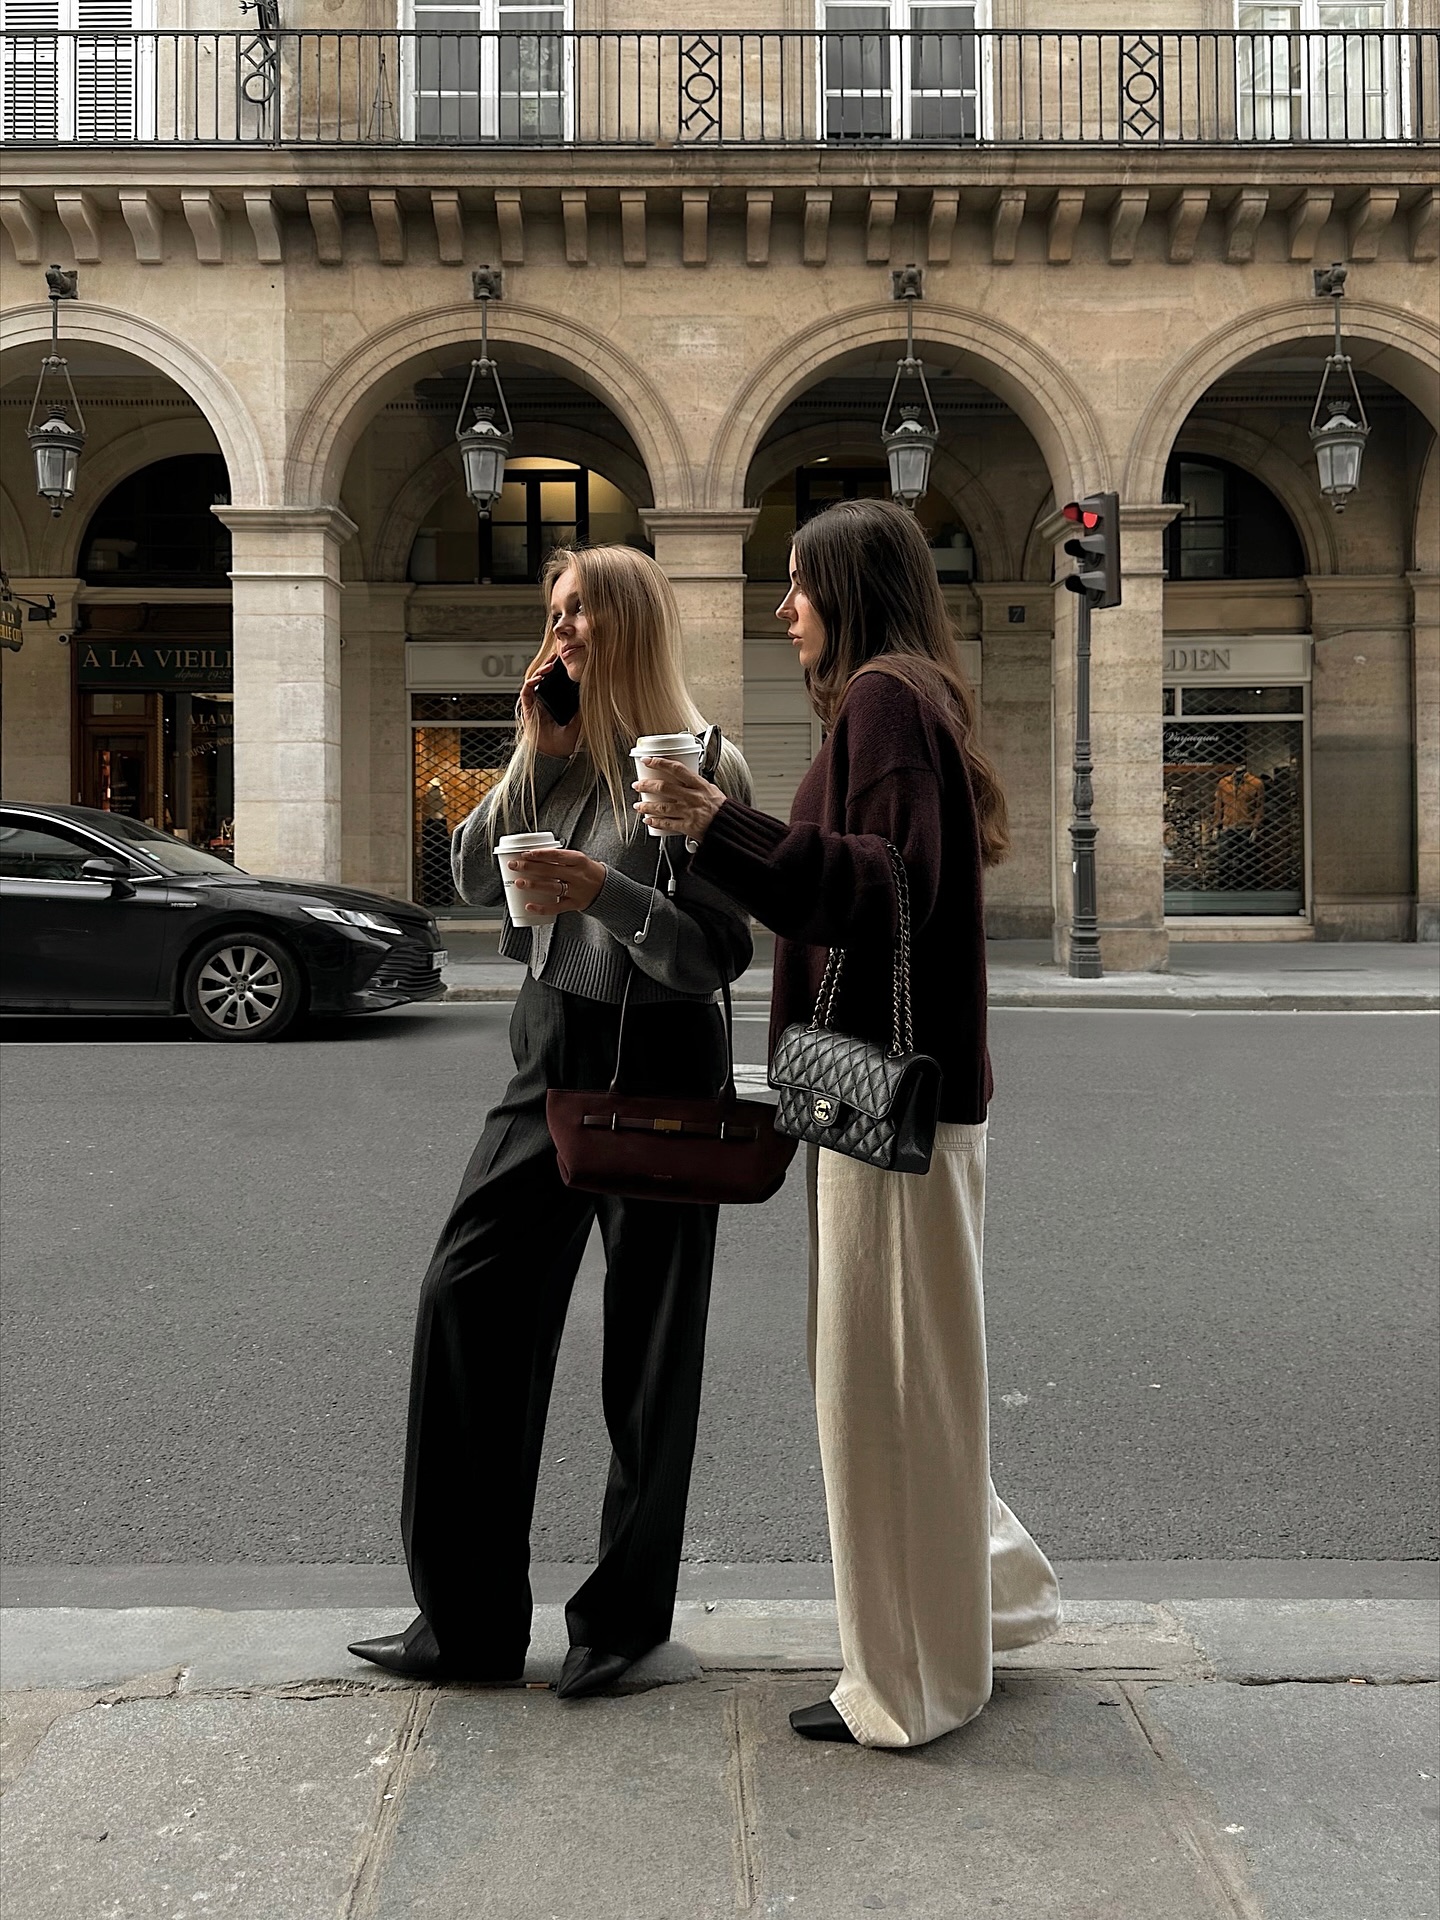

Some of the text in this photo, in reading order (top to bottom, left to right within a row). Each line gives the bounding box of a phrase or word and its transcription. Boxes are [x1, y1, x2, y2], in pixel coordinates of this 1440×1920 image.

[1013, 607, 1022, 621] 7
[82, 645, 101, 668] À
[109, 650, 145, 668] LA
[1163, 649, 1230, 671] DEN
[199, 714, 217, 725] LA
